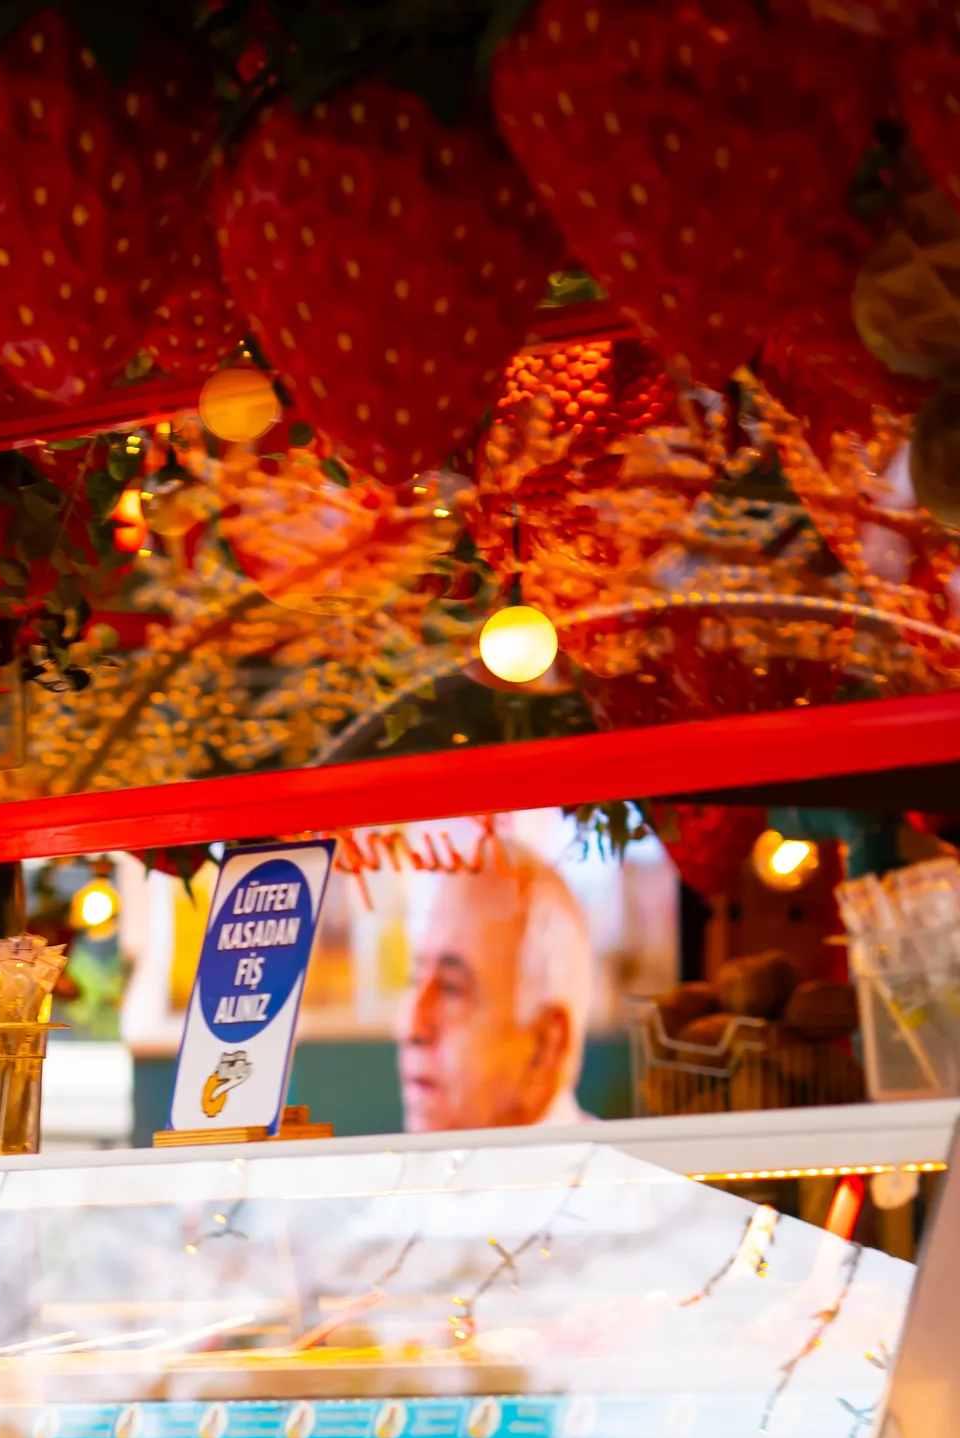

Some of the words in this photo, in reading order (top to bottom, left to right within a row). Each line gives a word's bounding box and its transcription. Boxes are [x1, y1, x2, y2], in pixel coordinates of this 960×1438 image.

[232, 880, 302, 915] LÜTFEN
[216, 917, 302, 951] KASADAN
[233, 952, 266, 990] FİŞ
[212, 992, 273, 1025] ALINIZ
